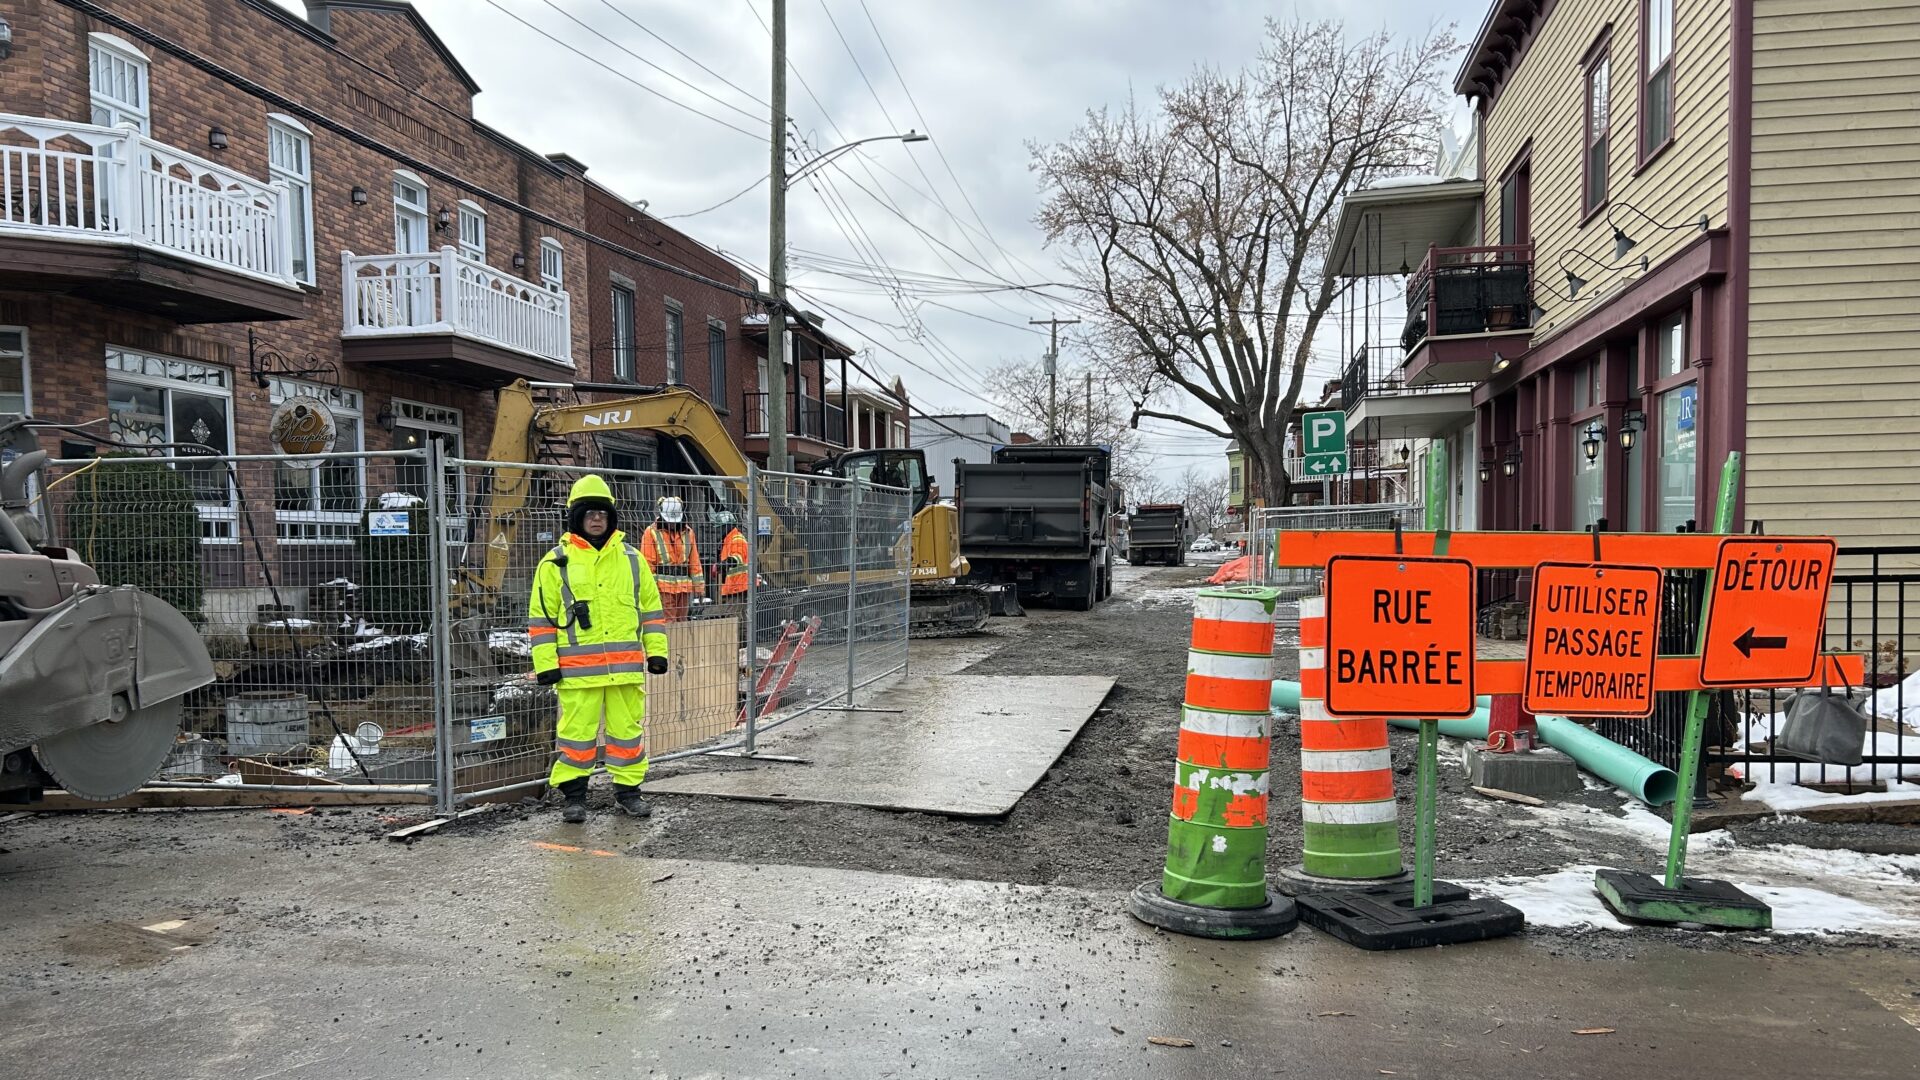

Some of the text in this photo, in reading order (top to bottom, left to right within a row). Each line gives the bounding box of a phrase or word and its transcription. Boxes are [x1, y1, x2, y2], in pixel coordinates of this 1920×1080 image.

[583, 410, 631, 427] NRJ
[1681, 396, 1692, 420] IR
[1312, 418, 1337, 448] P
[1723, 552, 1822, 591] DÉTOUR
[1373, 589, 1432, 625] RUE
[1547, 585, 1648, 616] UTILISER
[1544, 627, 1643, 658] PASSAGE
[1337, 643, 1463, 685] BARRÉE
[1535, 670, 1647, 700] TEMPORAIRE
